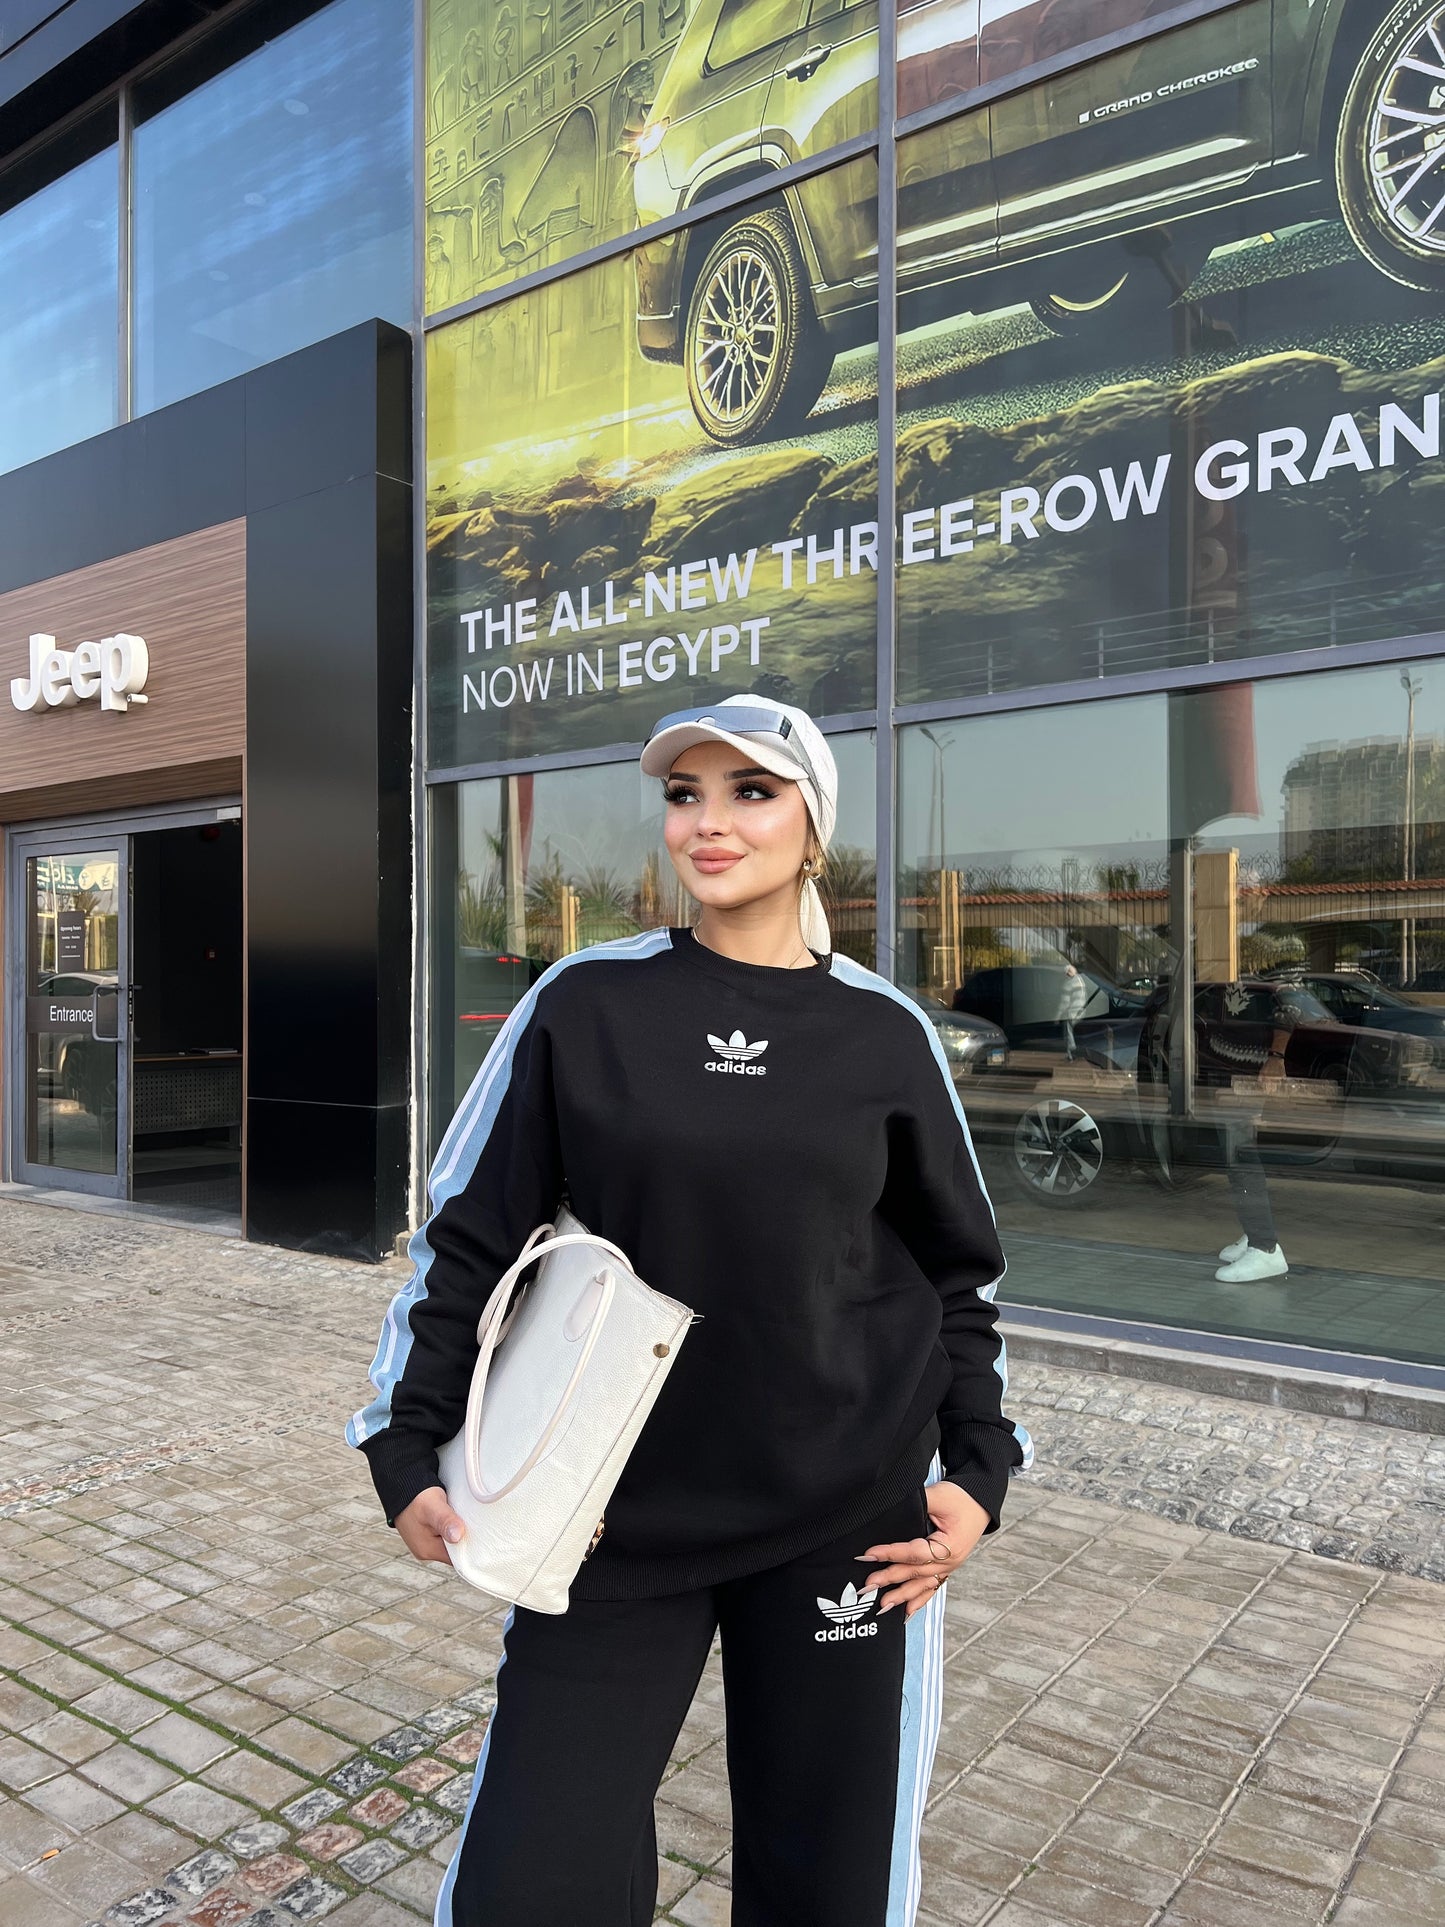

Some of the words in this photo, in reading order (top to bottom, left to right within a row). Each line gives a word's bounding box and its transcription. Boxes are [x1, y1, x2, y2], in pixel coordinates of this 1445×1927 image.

[1093, 91, 1152, 118] GRAND
[1156, 57, 1260, 97] CHEROKEE
[460, 598, 537, 654] THE
[549, 547, 758, 637] ALL-NEW
[771, 453, 1172, 590] THREE-ROW
[1194, 392, 1440, 501] GRAN
[10, 633, 149, 712] Jeep
[462, 657, 554, 714] NOW
[567, 648, 604, 696] IN
[619, 616, 771, 688] EGYPT
[49, 1005, 94, 1022] Entrance
[704, 1060, 767, 1076] adidas
[814, 1621, 878, 1642] adidas
